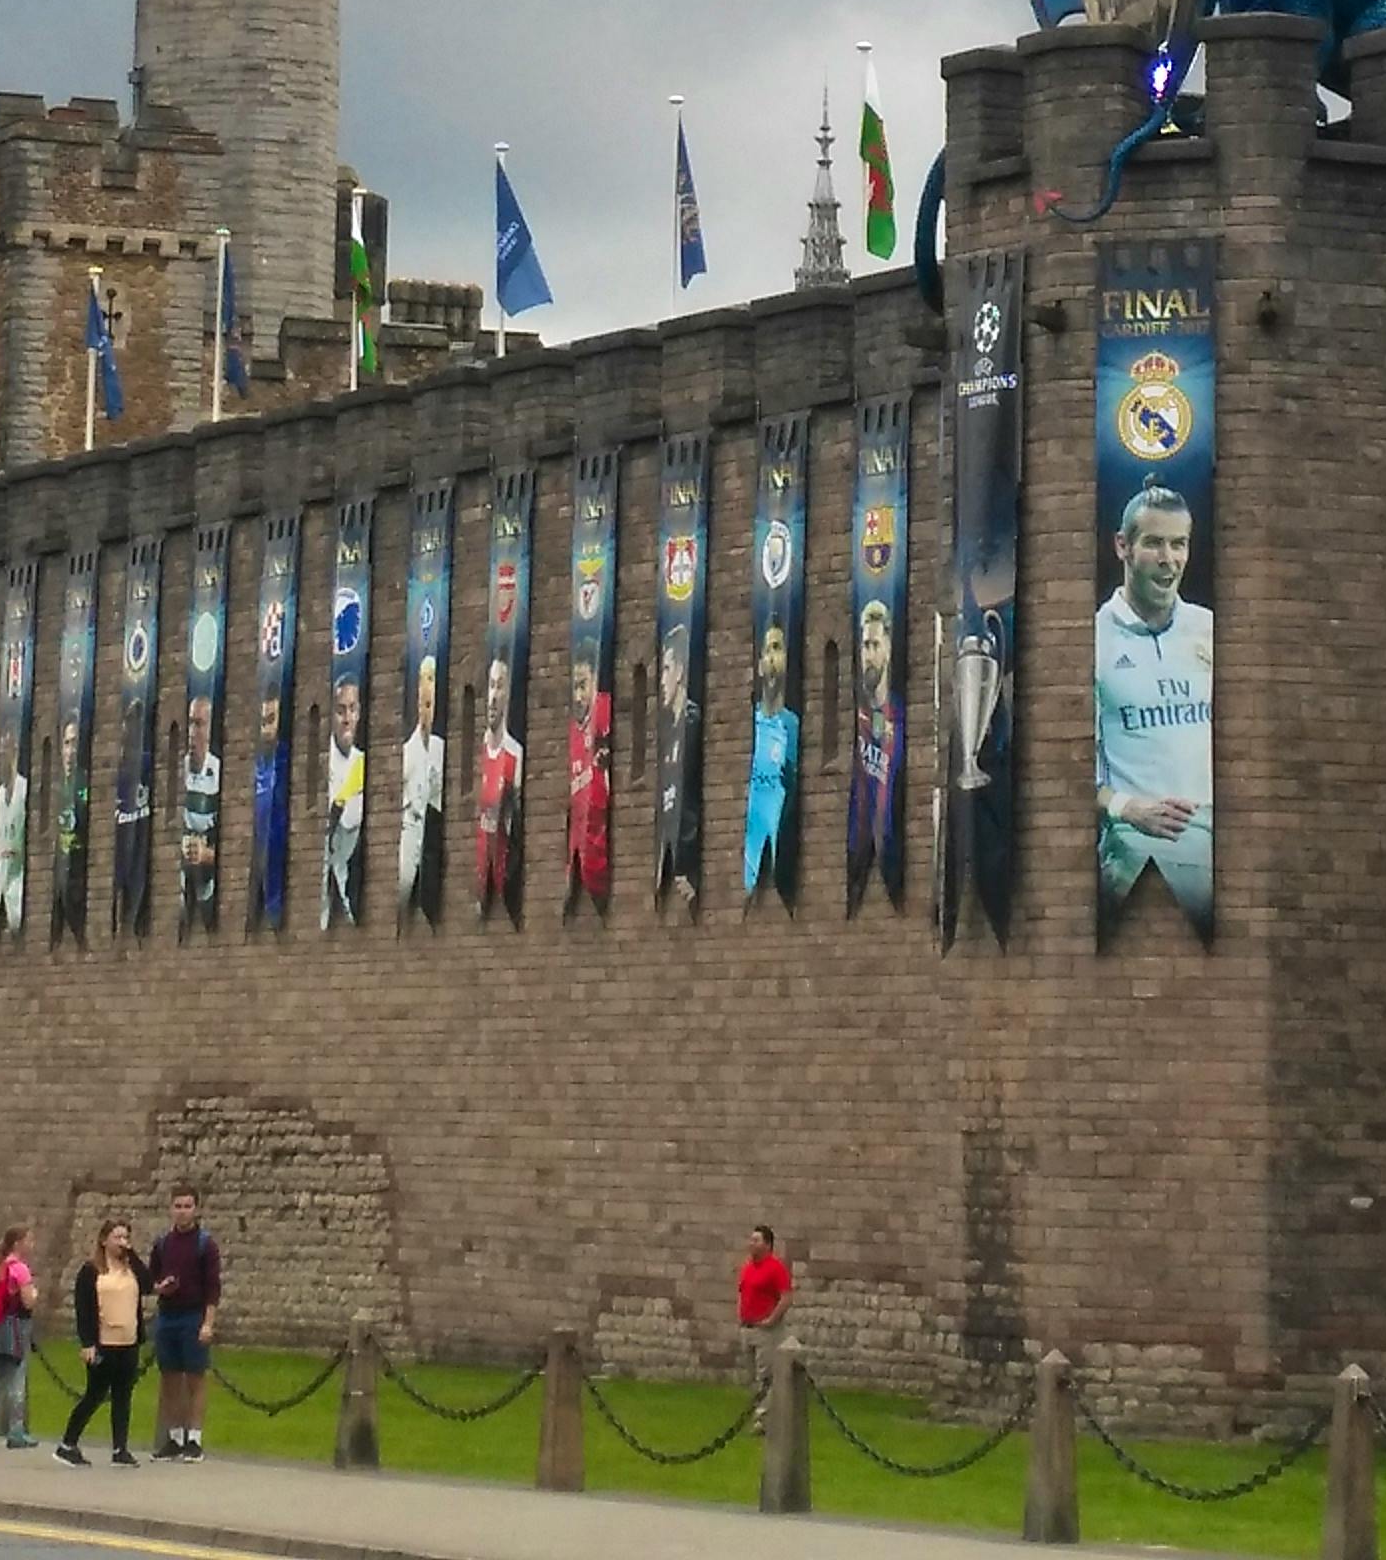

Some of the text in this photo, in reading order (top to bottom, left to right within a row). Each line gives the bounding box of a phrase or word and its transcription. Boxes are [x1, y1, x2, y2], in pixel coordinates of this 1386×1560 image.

[1102, 288, 1211, 319] FINAL
[958, 372, 1018, 397] CHAMPIONS
[1156, 678, 1190, 698] Fly
